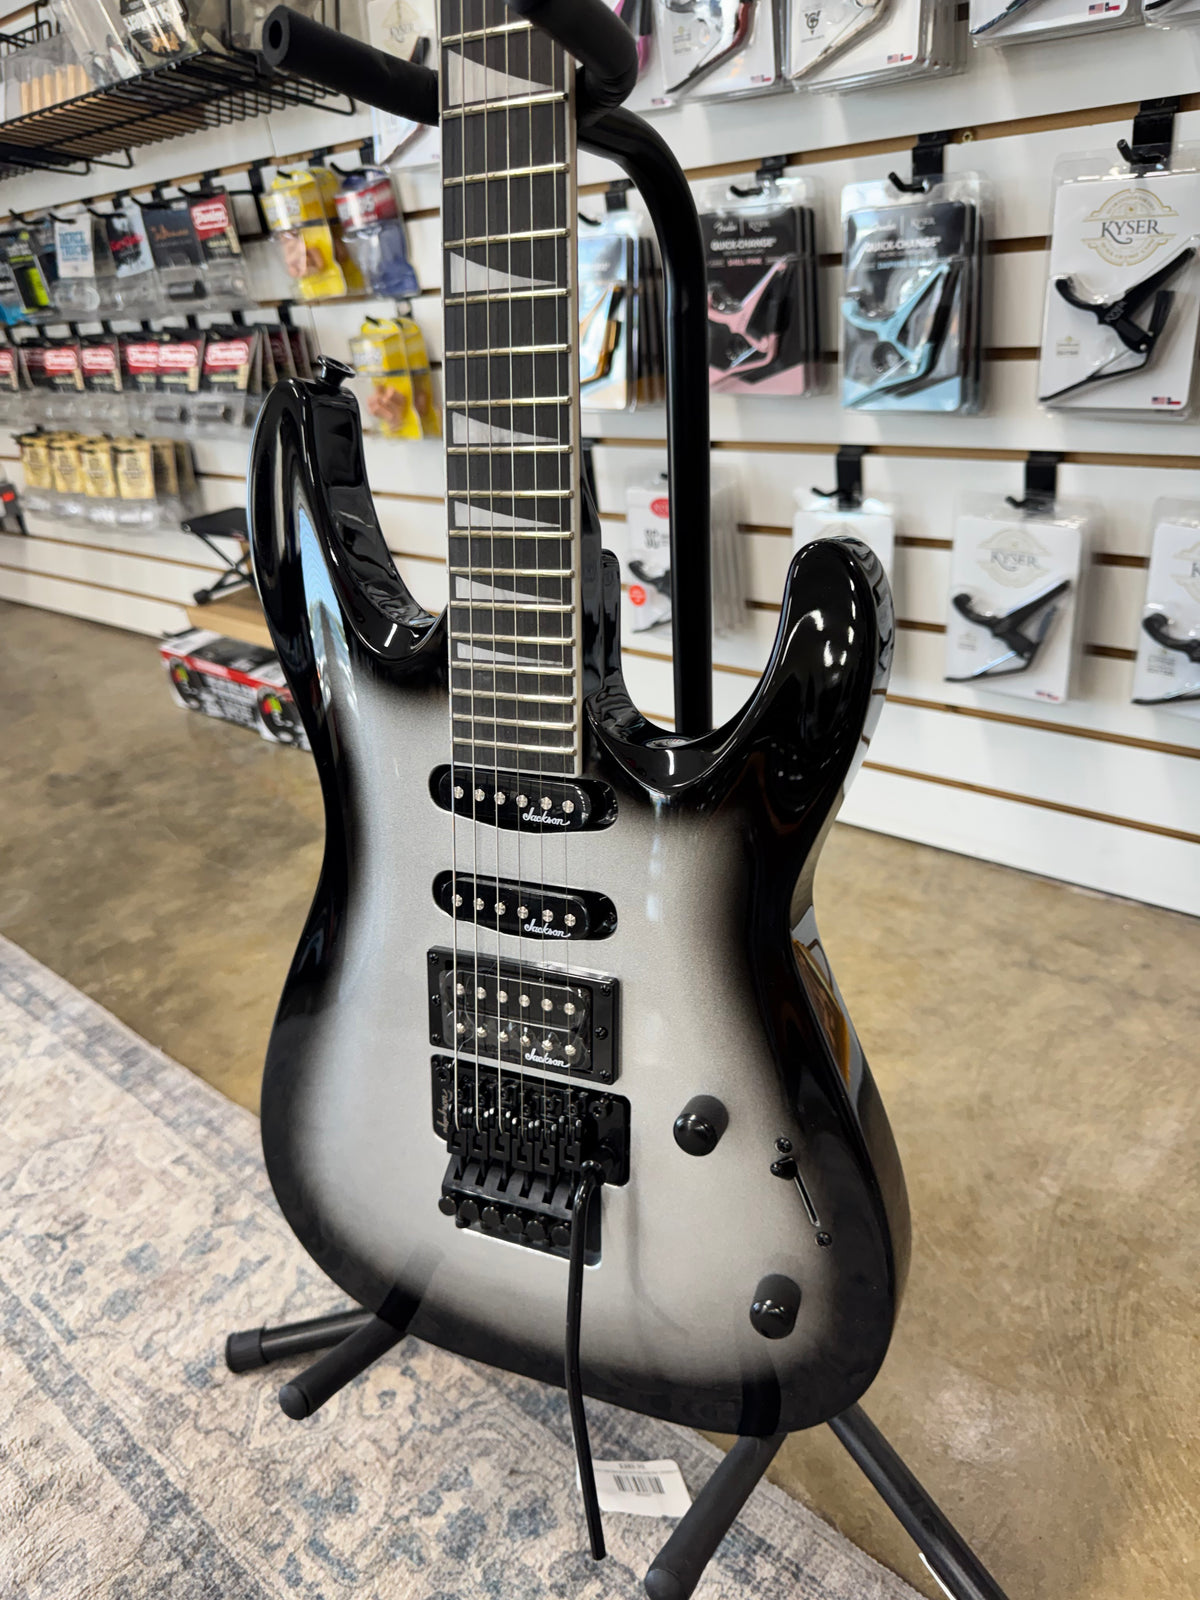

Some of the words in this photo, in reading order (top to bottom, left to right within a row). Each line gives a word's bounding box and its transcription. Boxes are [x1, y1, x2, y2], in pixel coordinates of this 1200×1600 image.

[1101, 219, 1160, 245] KYSER
[990, 551, 1040, 573] KYSER
[522, 807, 571, 826] Jackson
[524, 918, 571, 938] Jackson
[525, 1048, 570, 1069] Jackson
